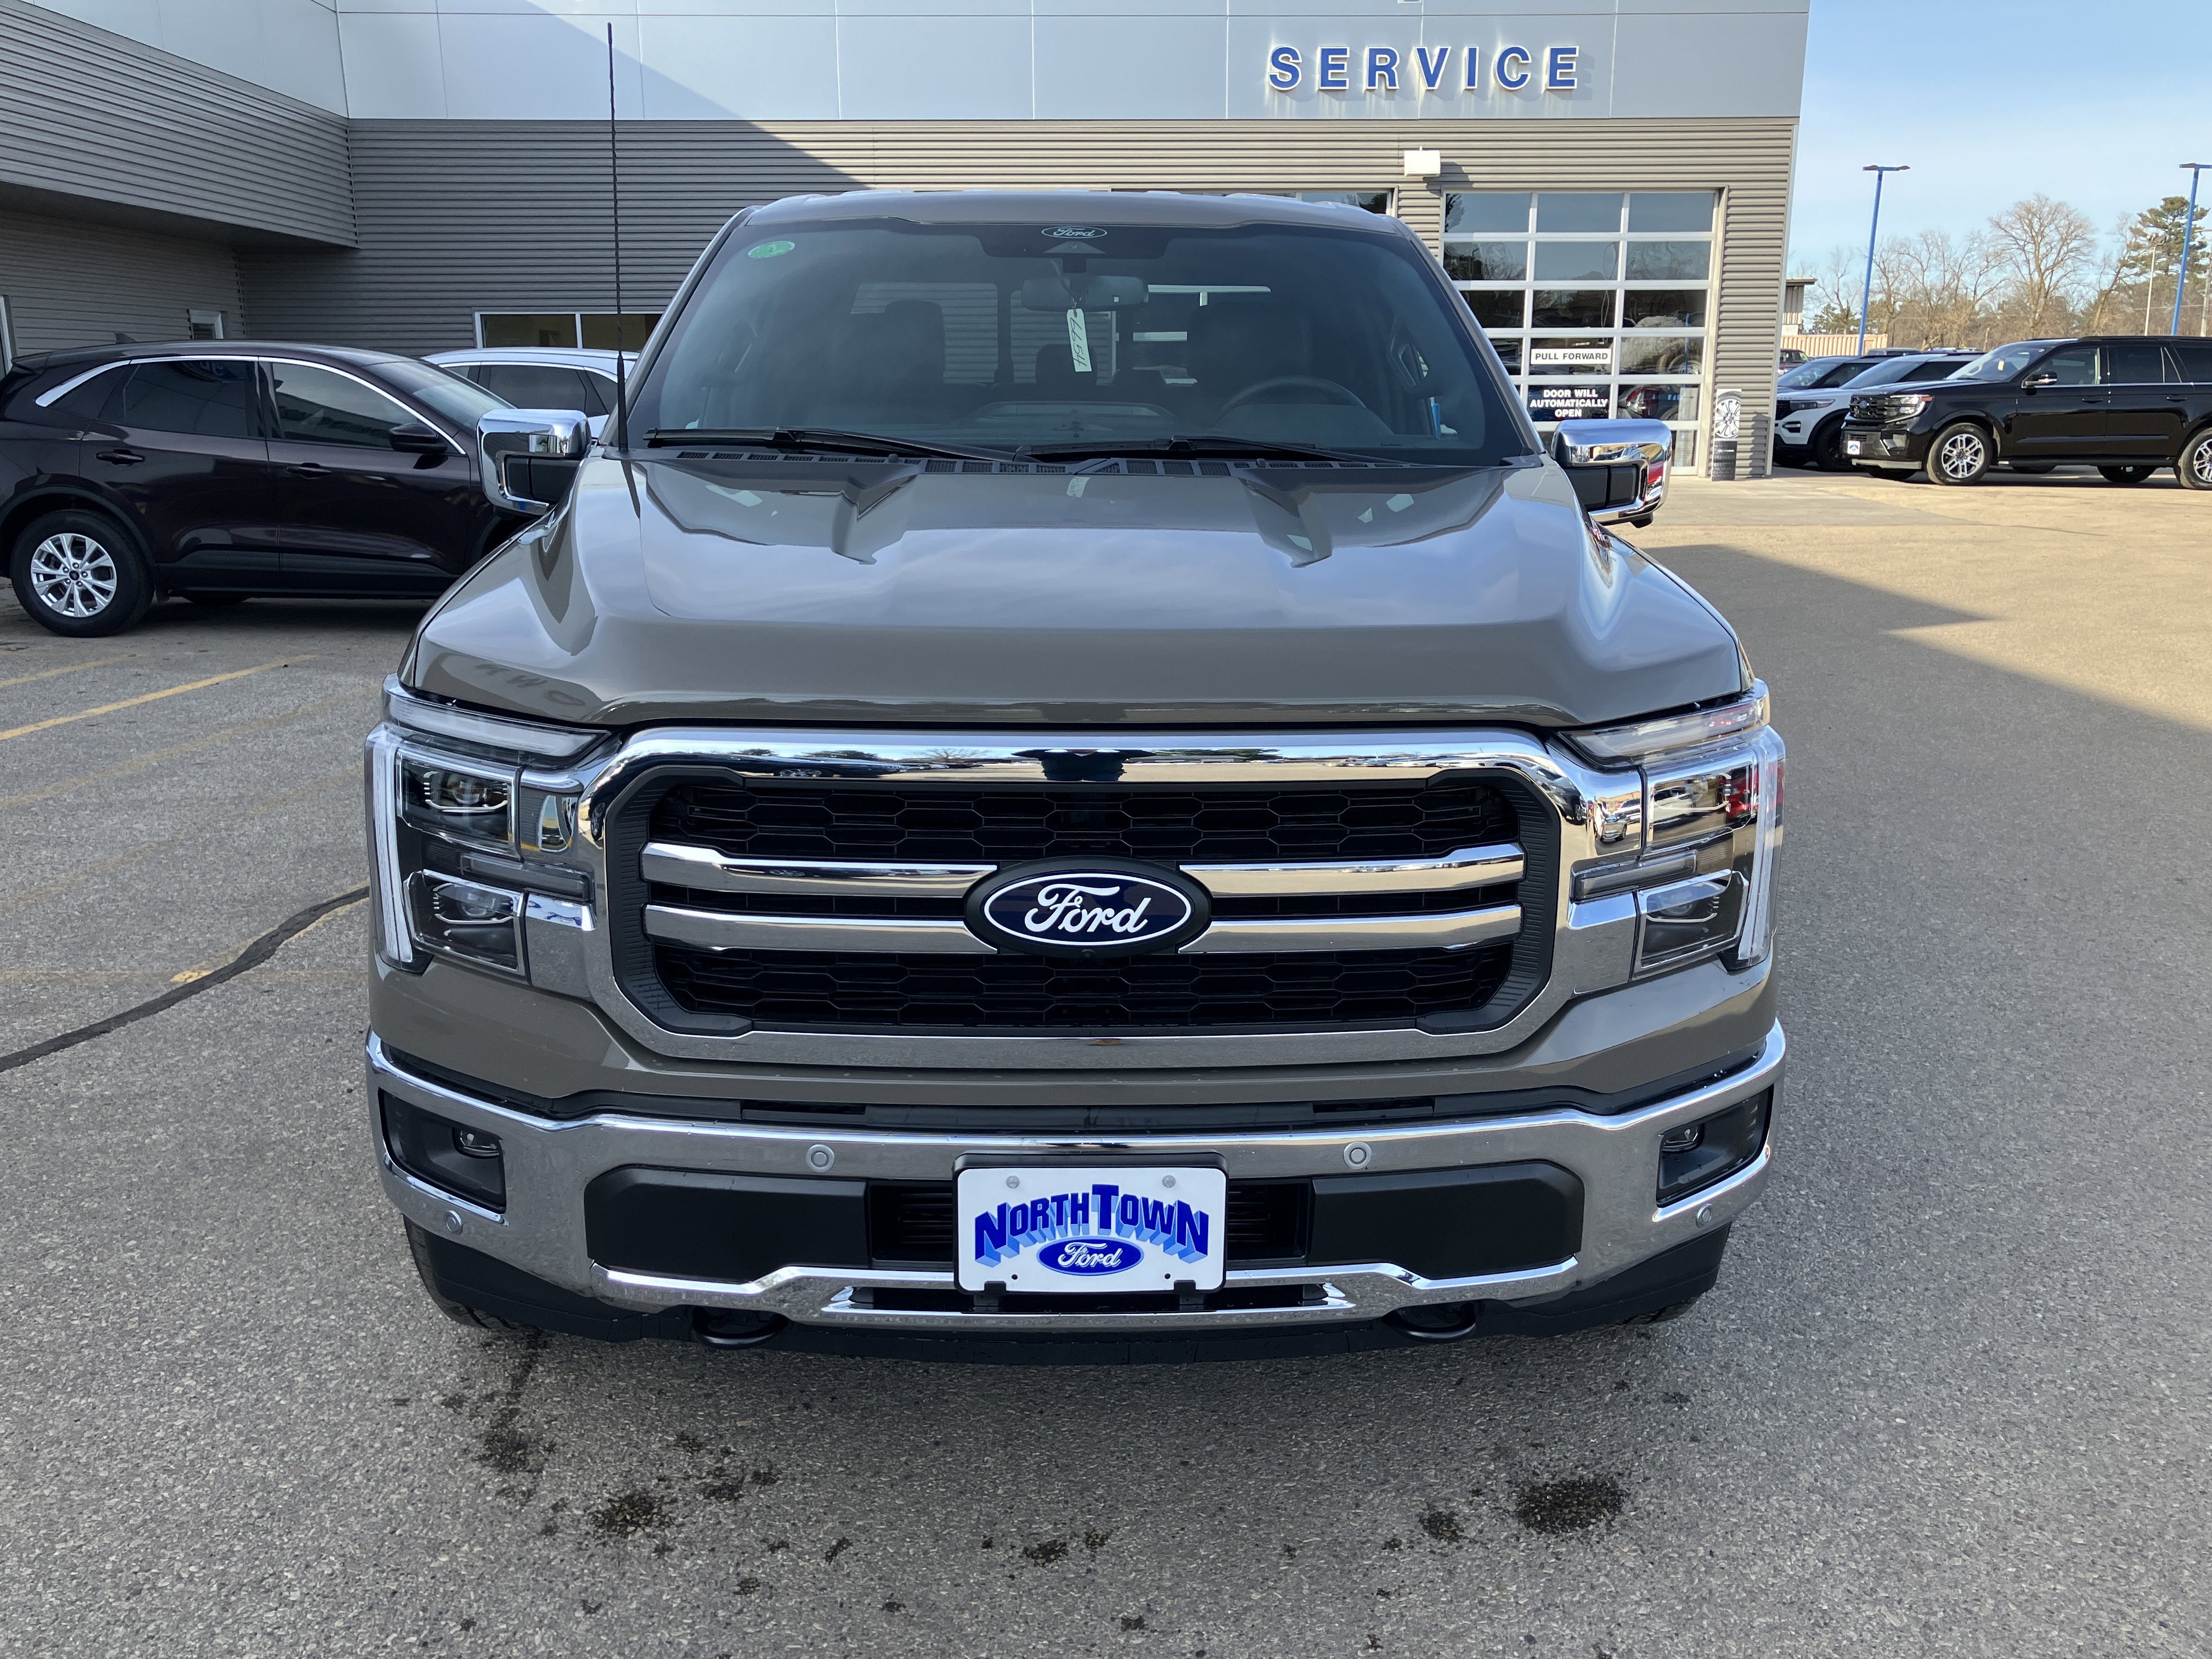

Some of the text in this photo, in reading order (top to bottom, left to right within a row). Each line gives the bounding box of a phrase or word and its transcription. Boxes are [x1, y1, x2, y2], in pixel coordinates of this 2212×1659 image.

[1268, 45, 1579, 91] SERVICE
[1053, 227, 1096, 236] Ford
[1070, 317, 1087, 367] 6654
[1543, 389, 1598, 398] DOOR WILL
[1530, 399, 1609, 408] AUTOMATICALLY
[1554, 409, 1582, 417] OPEN
[1024, 882, 1152, 933] Ford
[1058, 1242, 1122, 1268] Ford
